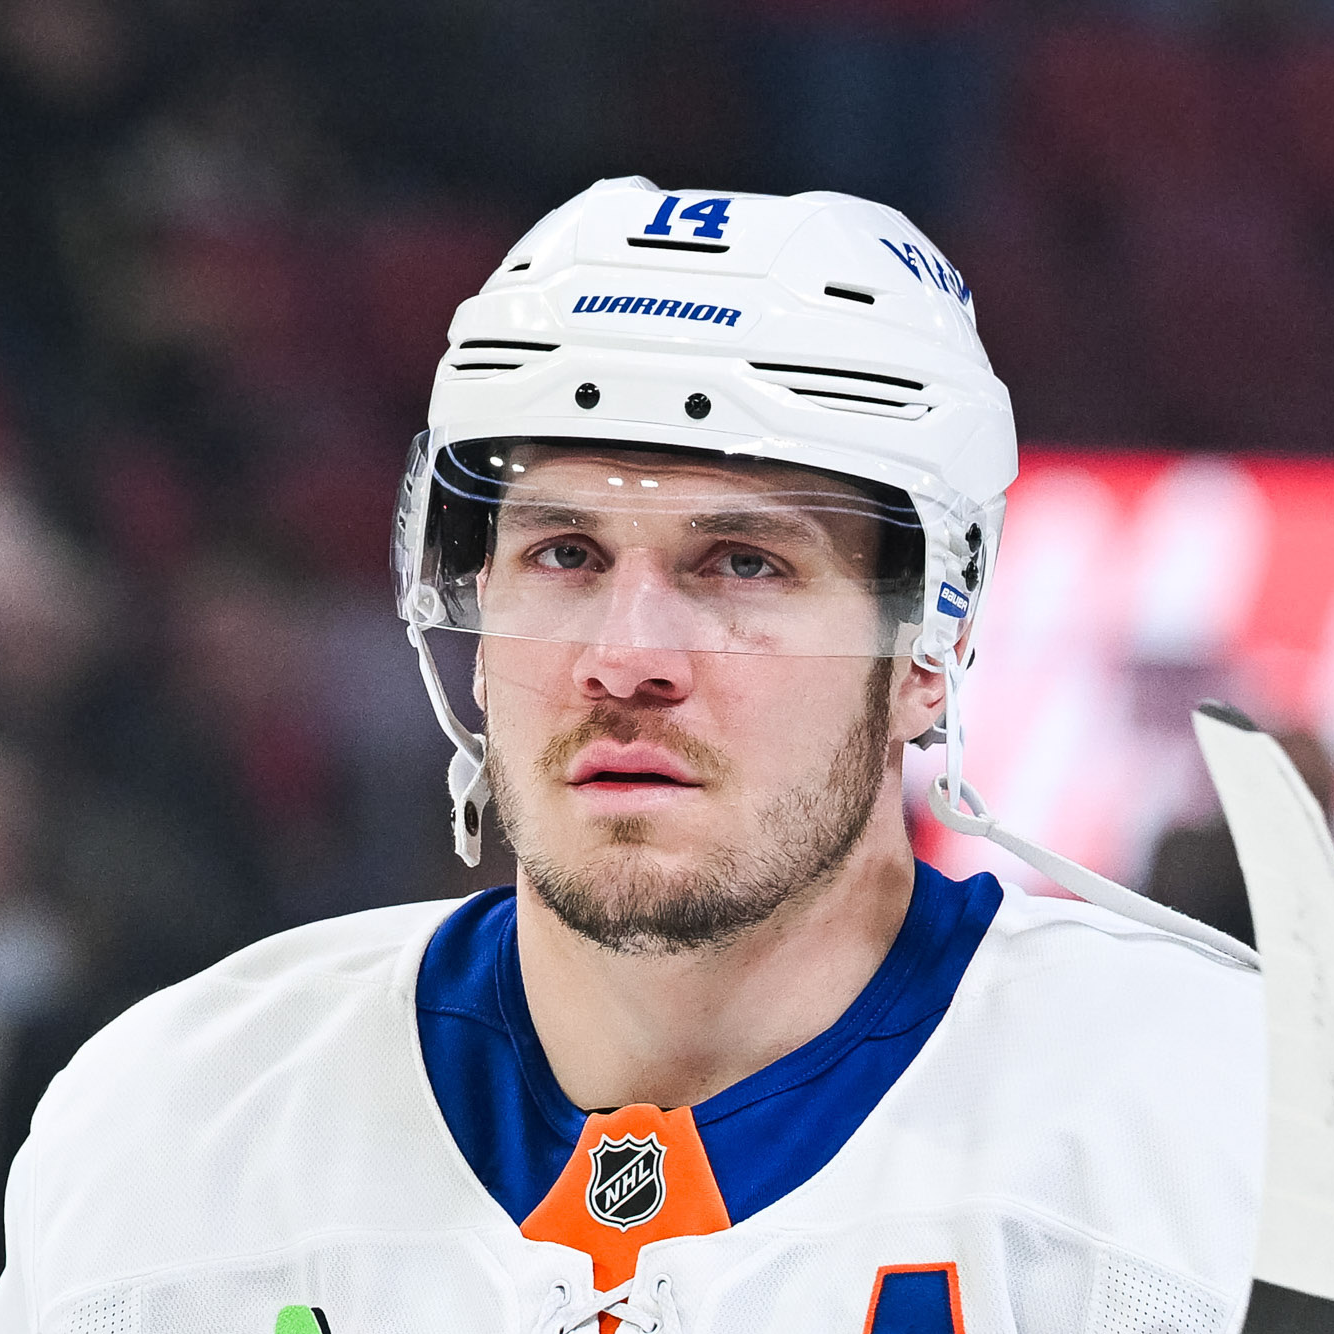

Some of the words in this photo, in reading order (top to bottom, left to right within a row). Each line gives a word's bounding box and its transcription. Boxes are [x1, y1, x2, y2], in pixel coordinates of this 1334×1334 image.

[644, 195, 730, 239] 14
[571, 294, 742, 328] WARRIOR
[605, 1159, 651, 1210] NHL
